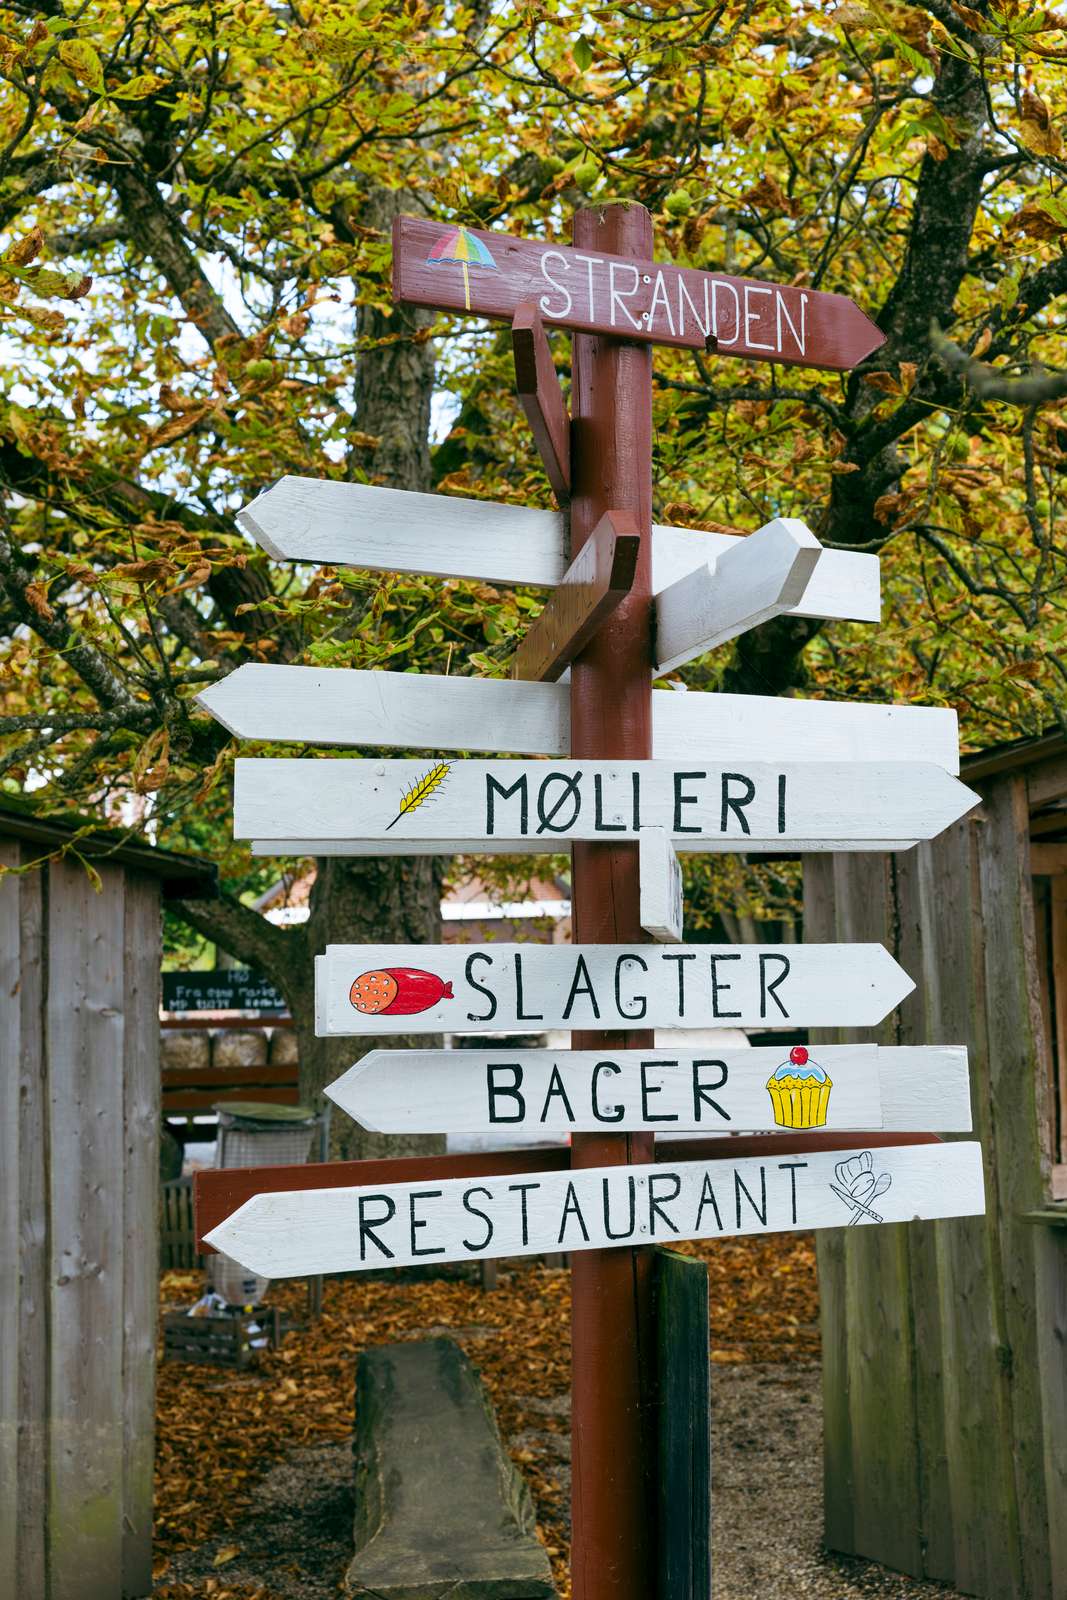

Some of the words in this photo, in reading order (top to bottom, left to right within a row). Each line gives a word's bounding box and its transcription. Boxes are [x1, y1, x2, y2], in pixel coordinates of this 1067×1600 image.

[539, 250, 808, 356] STRANDEN
[465, 952, 791, 1021] SLAGTER
[487, 1060, 732, 1124] BAGER
[359, 1162, 808, 1261] RESTAURANT
